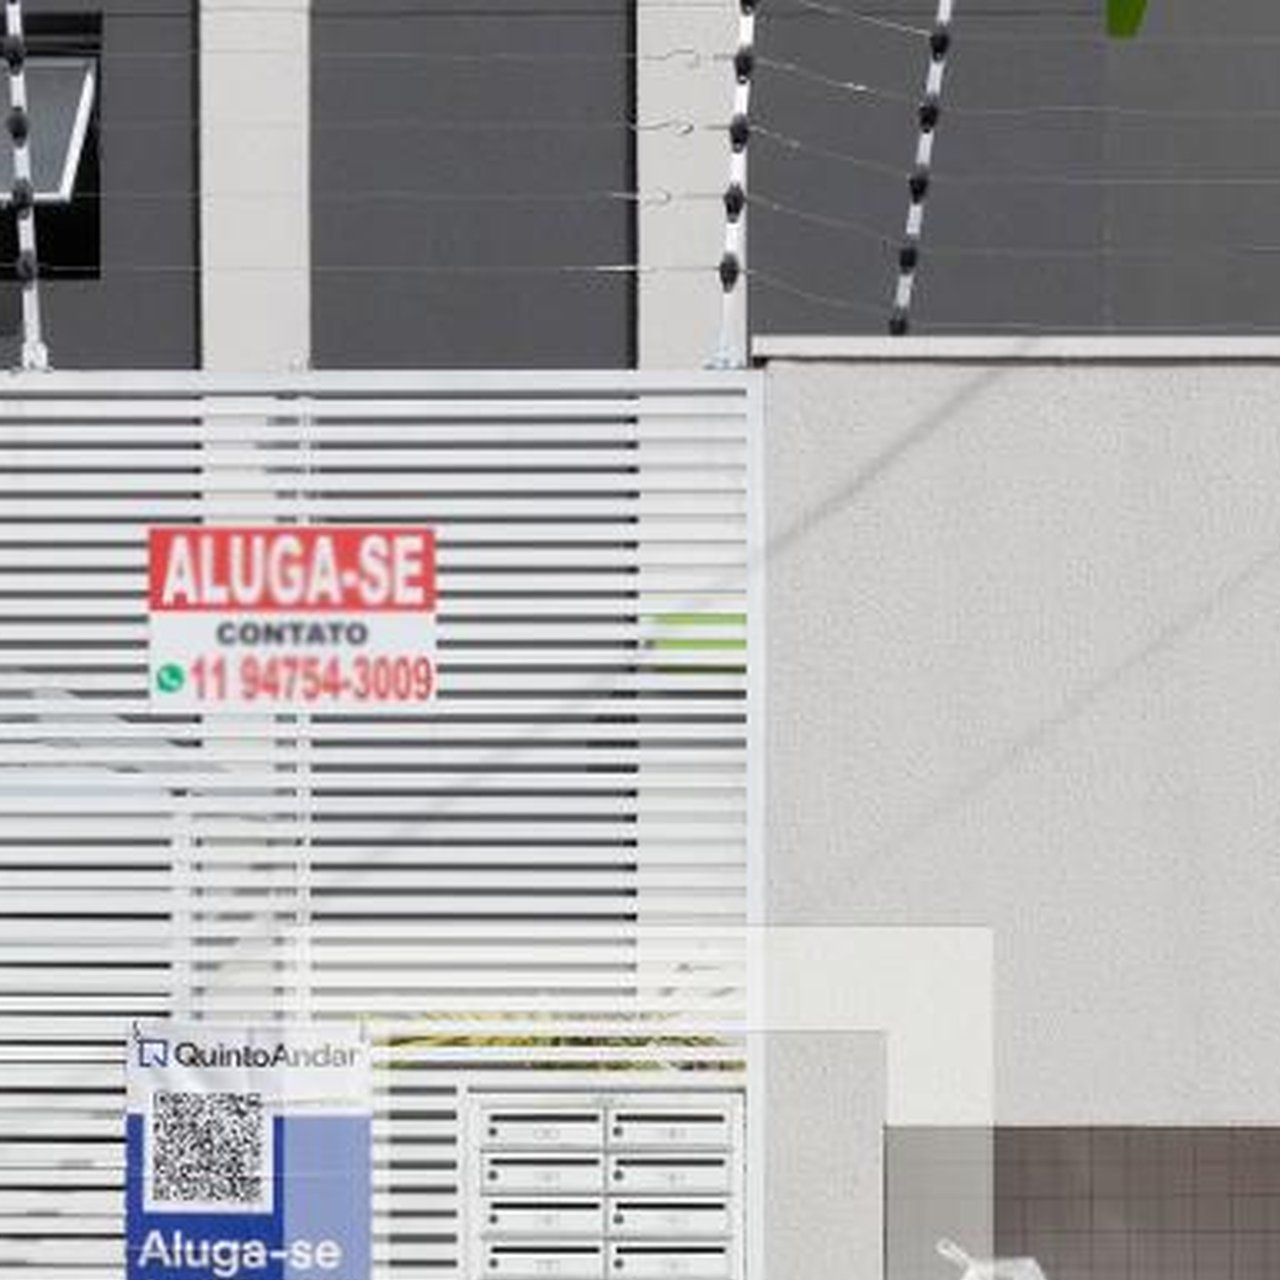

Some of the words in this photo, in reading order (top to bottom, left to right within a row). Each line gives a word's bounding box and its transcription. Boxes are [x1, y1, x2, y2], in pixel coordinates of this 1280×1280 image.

[161, 533, 425, 606] ALUGA-SE
[216, 621, 369, 647] CONTATO
[189, 655, 227, 700] 11
[240, 655, 433, 700] 94754-3009
[173, 1041, 358, 1069] QuintoAndar
[137, 1229, 342, 1277] Aluga-se
